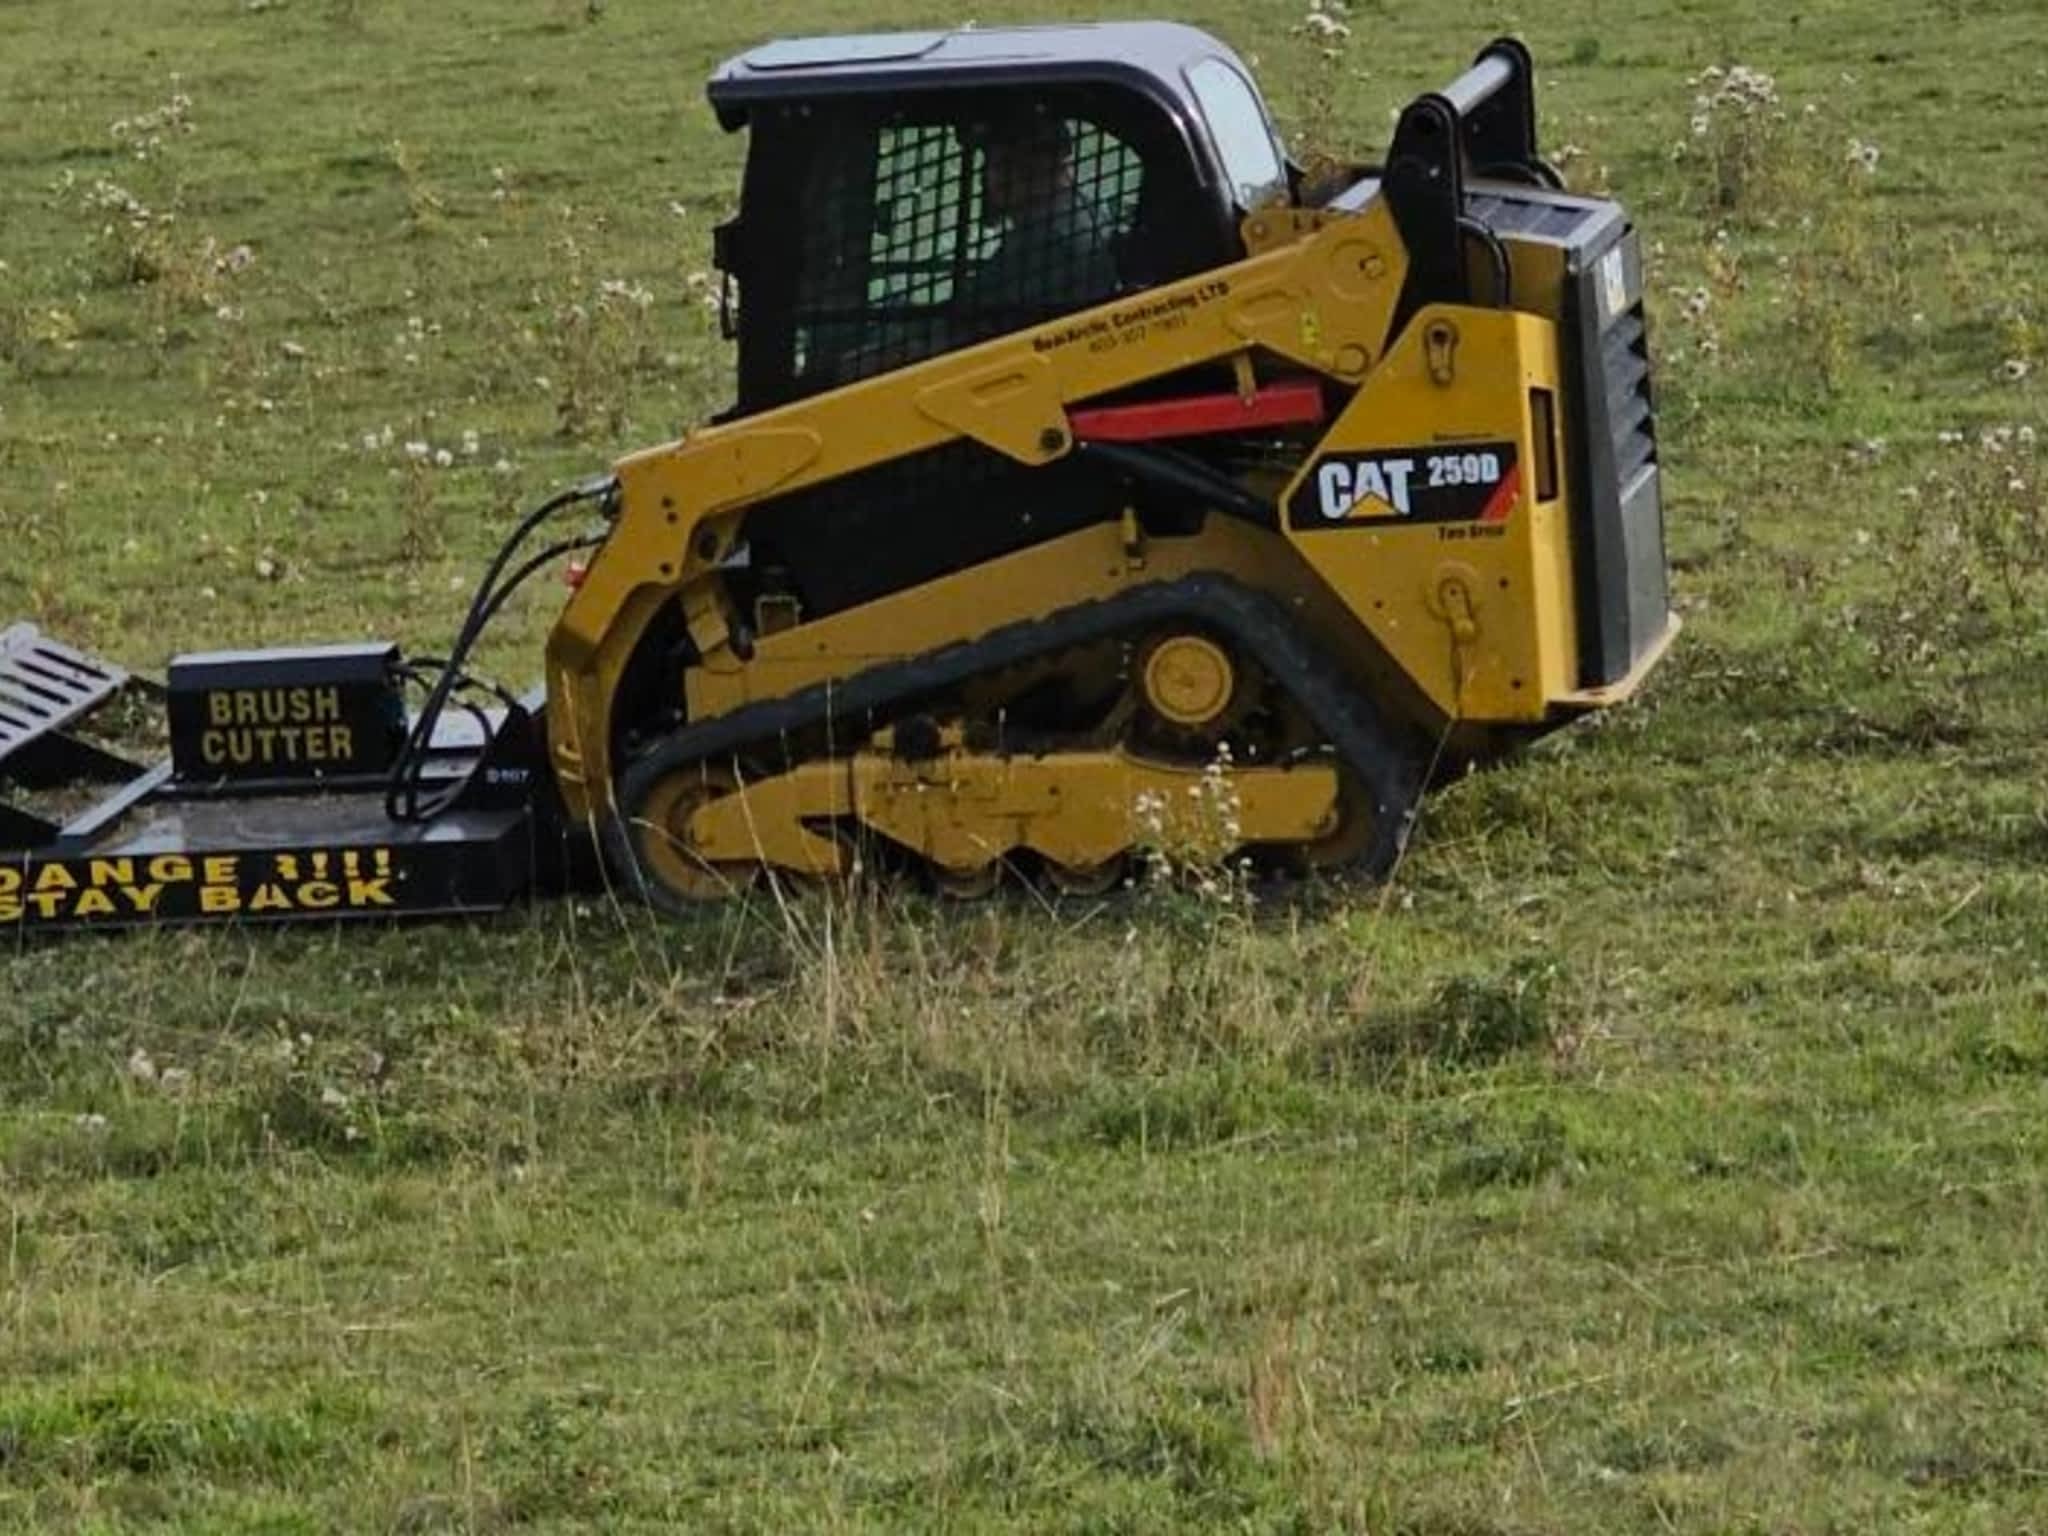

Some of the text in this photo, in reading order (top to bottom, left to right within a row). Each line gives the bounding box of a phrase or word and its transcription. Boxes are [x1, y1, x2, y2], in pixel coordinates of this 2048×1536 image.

[1112, 292, 1198, 327] Contracting
[1199, 281, 1230, 303] LTD
[1318, 453, 1500, 519] CAT 259D
[209, 687, 340, 725] BRUSH
[202, 724, 353, 763] CUTTER
[200, 878, 396, 912] BACK
